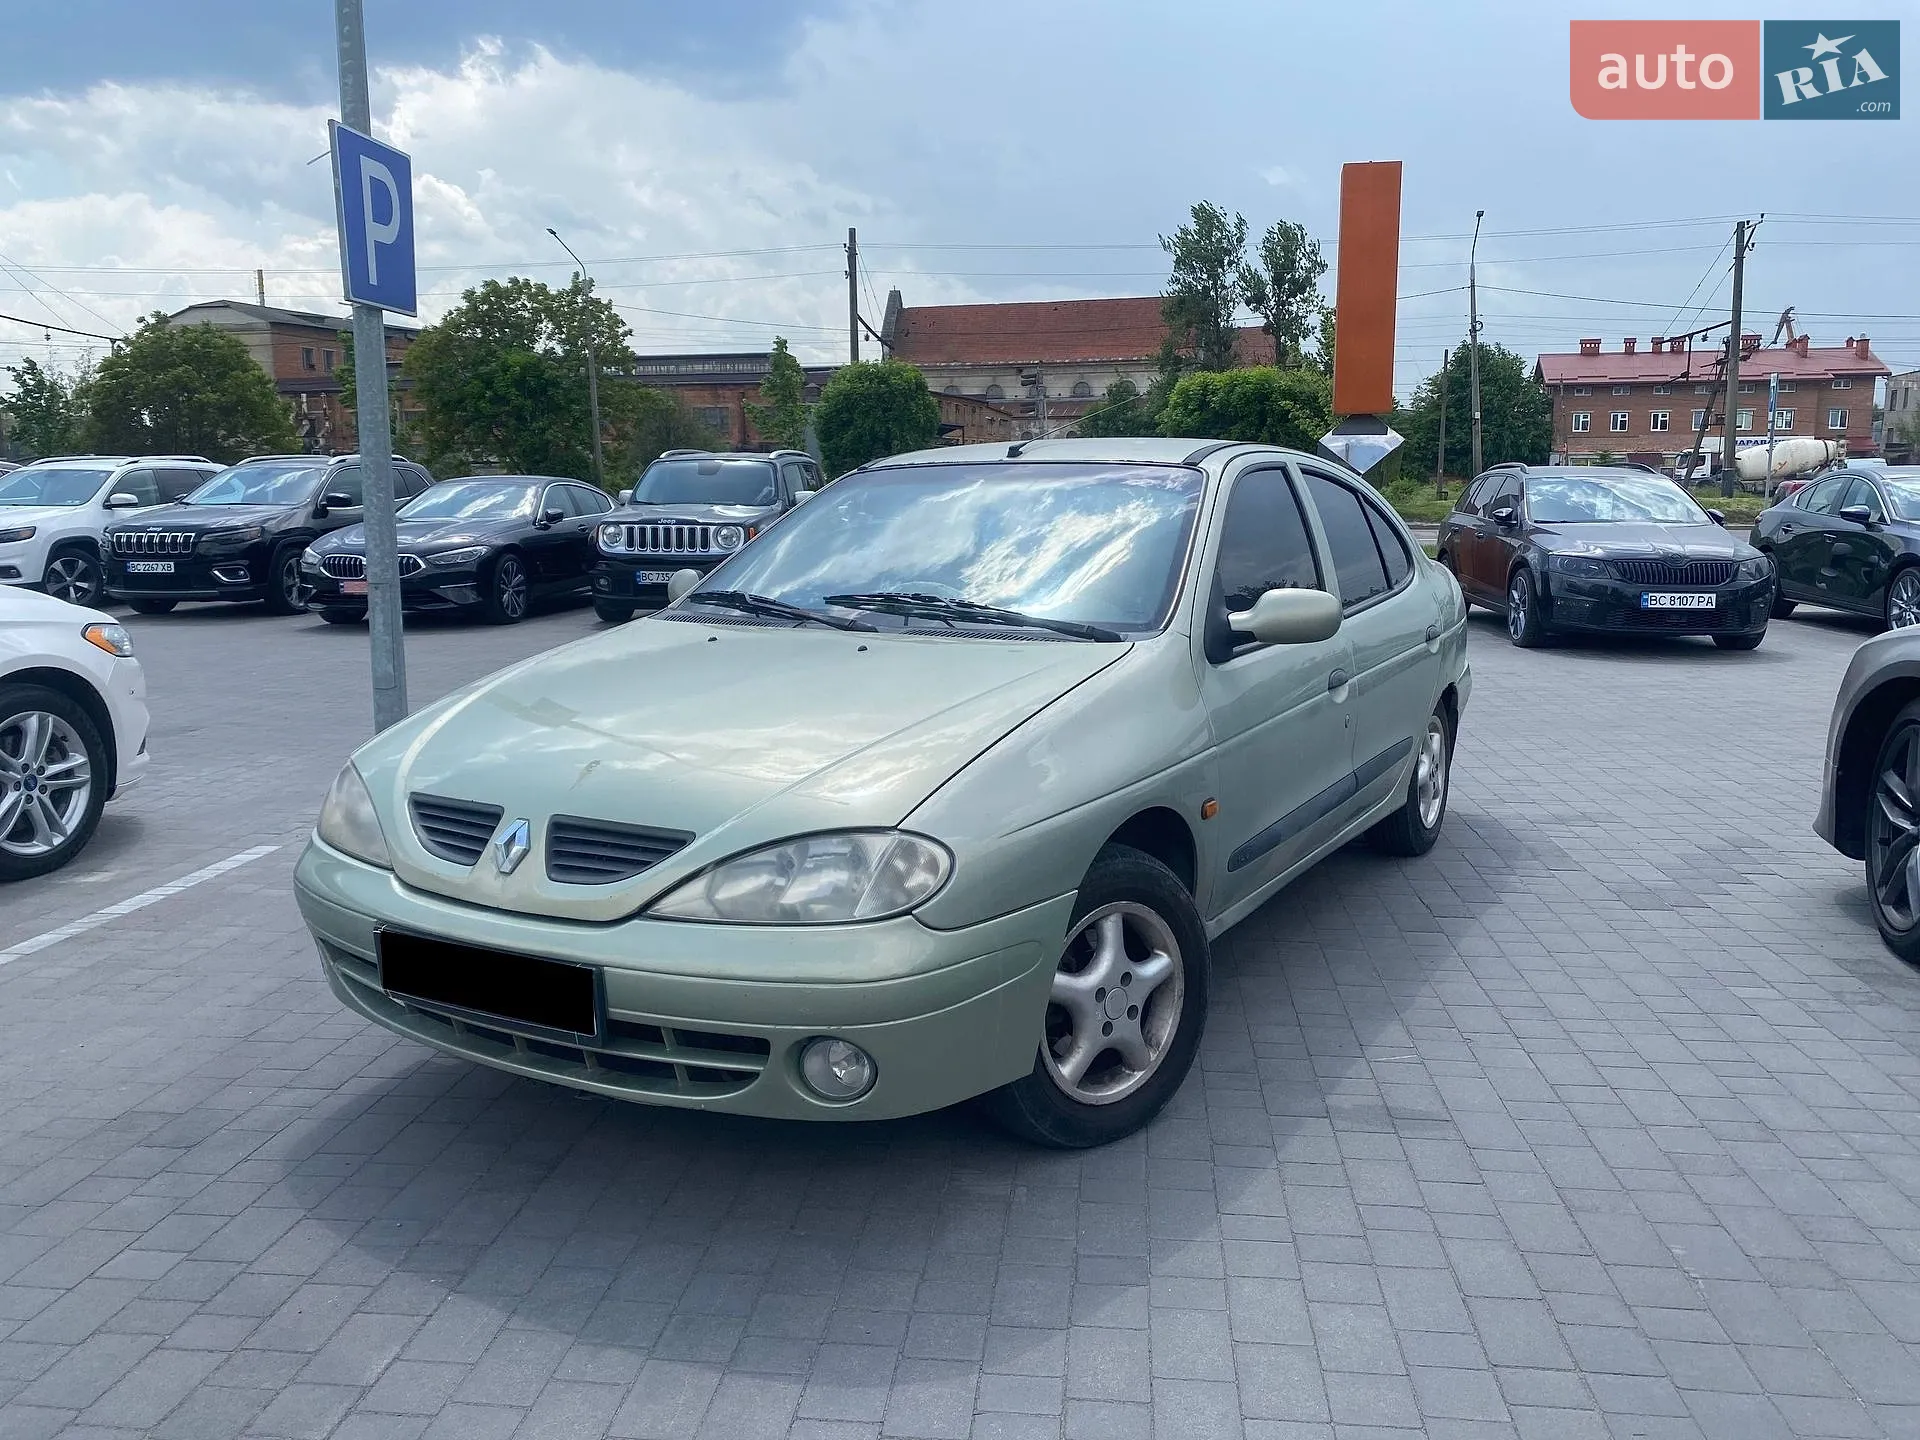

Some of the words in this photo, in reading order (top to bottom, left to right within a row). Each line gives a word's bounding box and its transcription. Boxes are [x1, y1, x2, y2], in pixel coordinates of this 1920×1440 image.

[359, 154, 400, 286] P
[641, 572, 654, 581] BC
[1649, 595, 1667, 606] BC
[1669, 595, 1695, 606] 8107
[1697, 596, 1714, 607] PA
